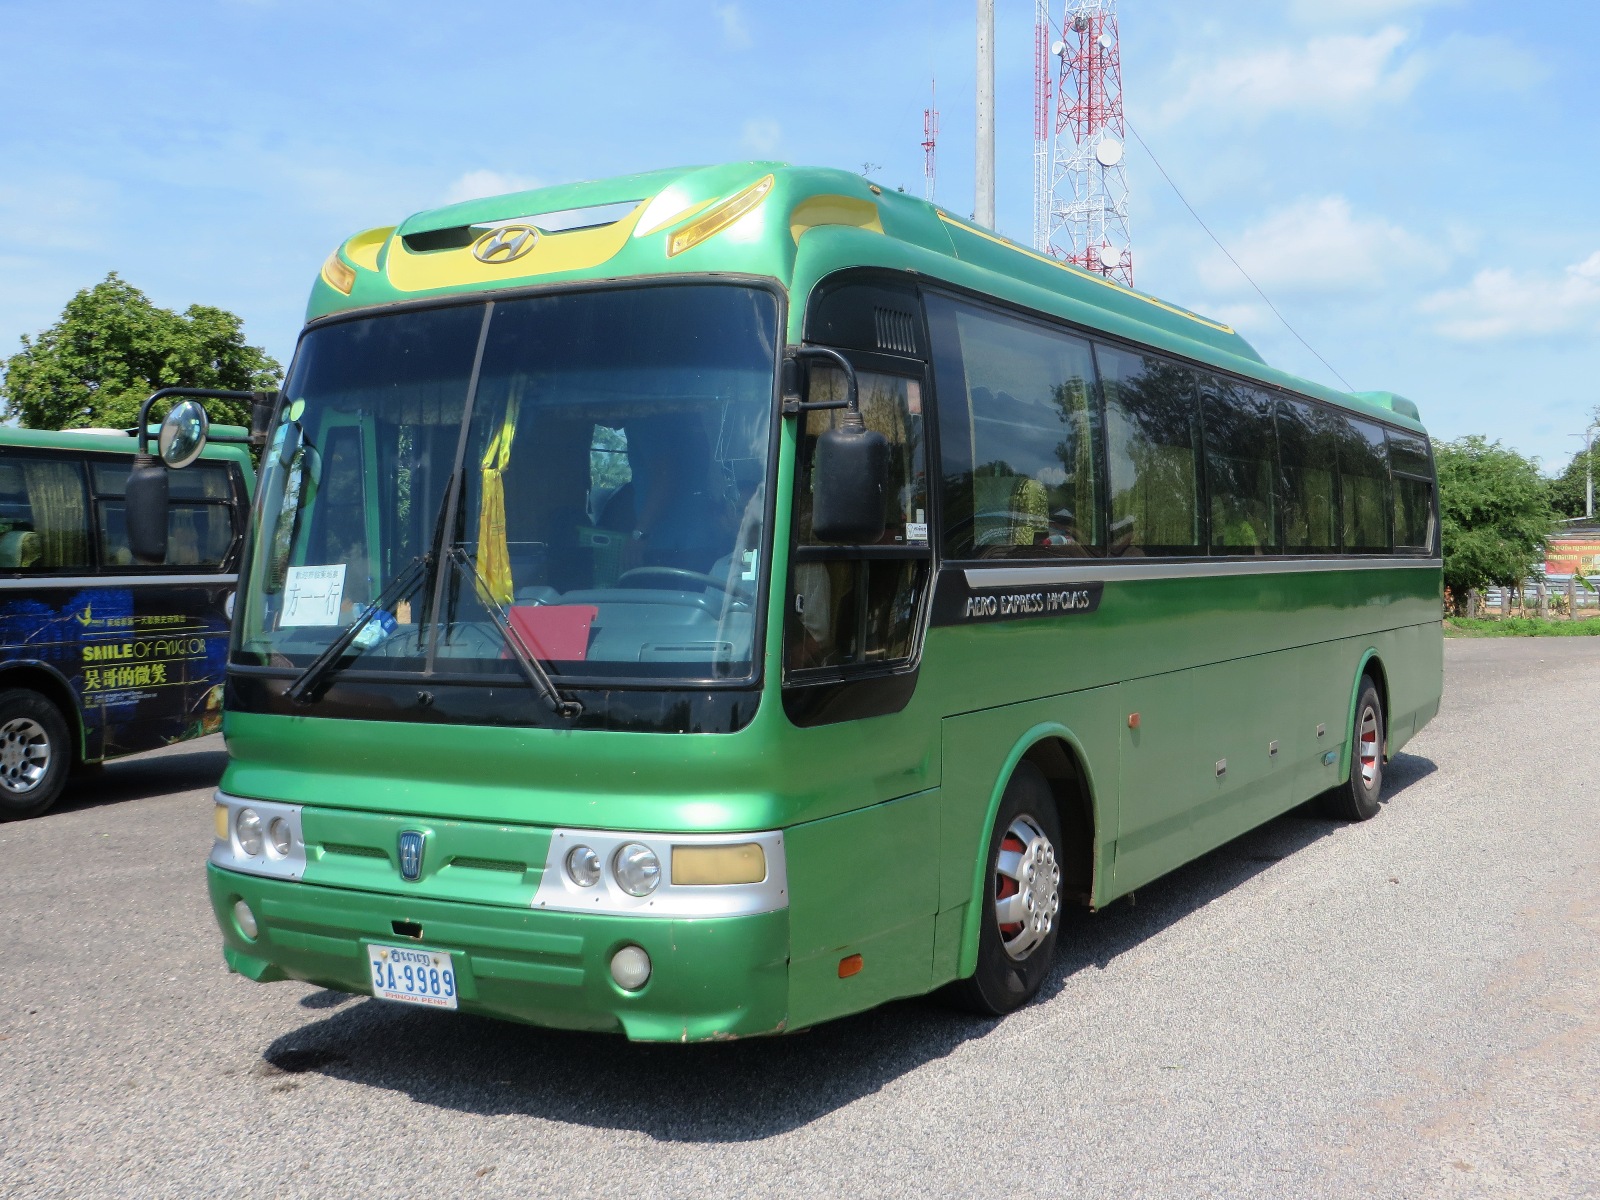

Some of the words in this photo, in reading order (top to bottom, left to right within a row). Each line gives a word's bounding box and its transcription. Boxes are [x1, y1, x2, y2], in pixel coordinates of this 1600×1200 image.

[966, 595, 997, 616] AERO
[1001, 593, 1043, 614] EXPRESS
[83, 643, 134, 661] SMILE
[373, 960, 455, 997] 3A-9989
[385, 992, 419, 1002] PHNOM
[421, 998, 448, 1006] PENH
